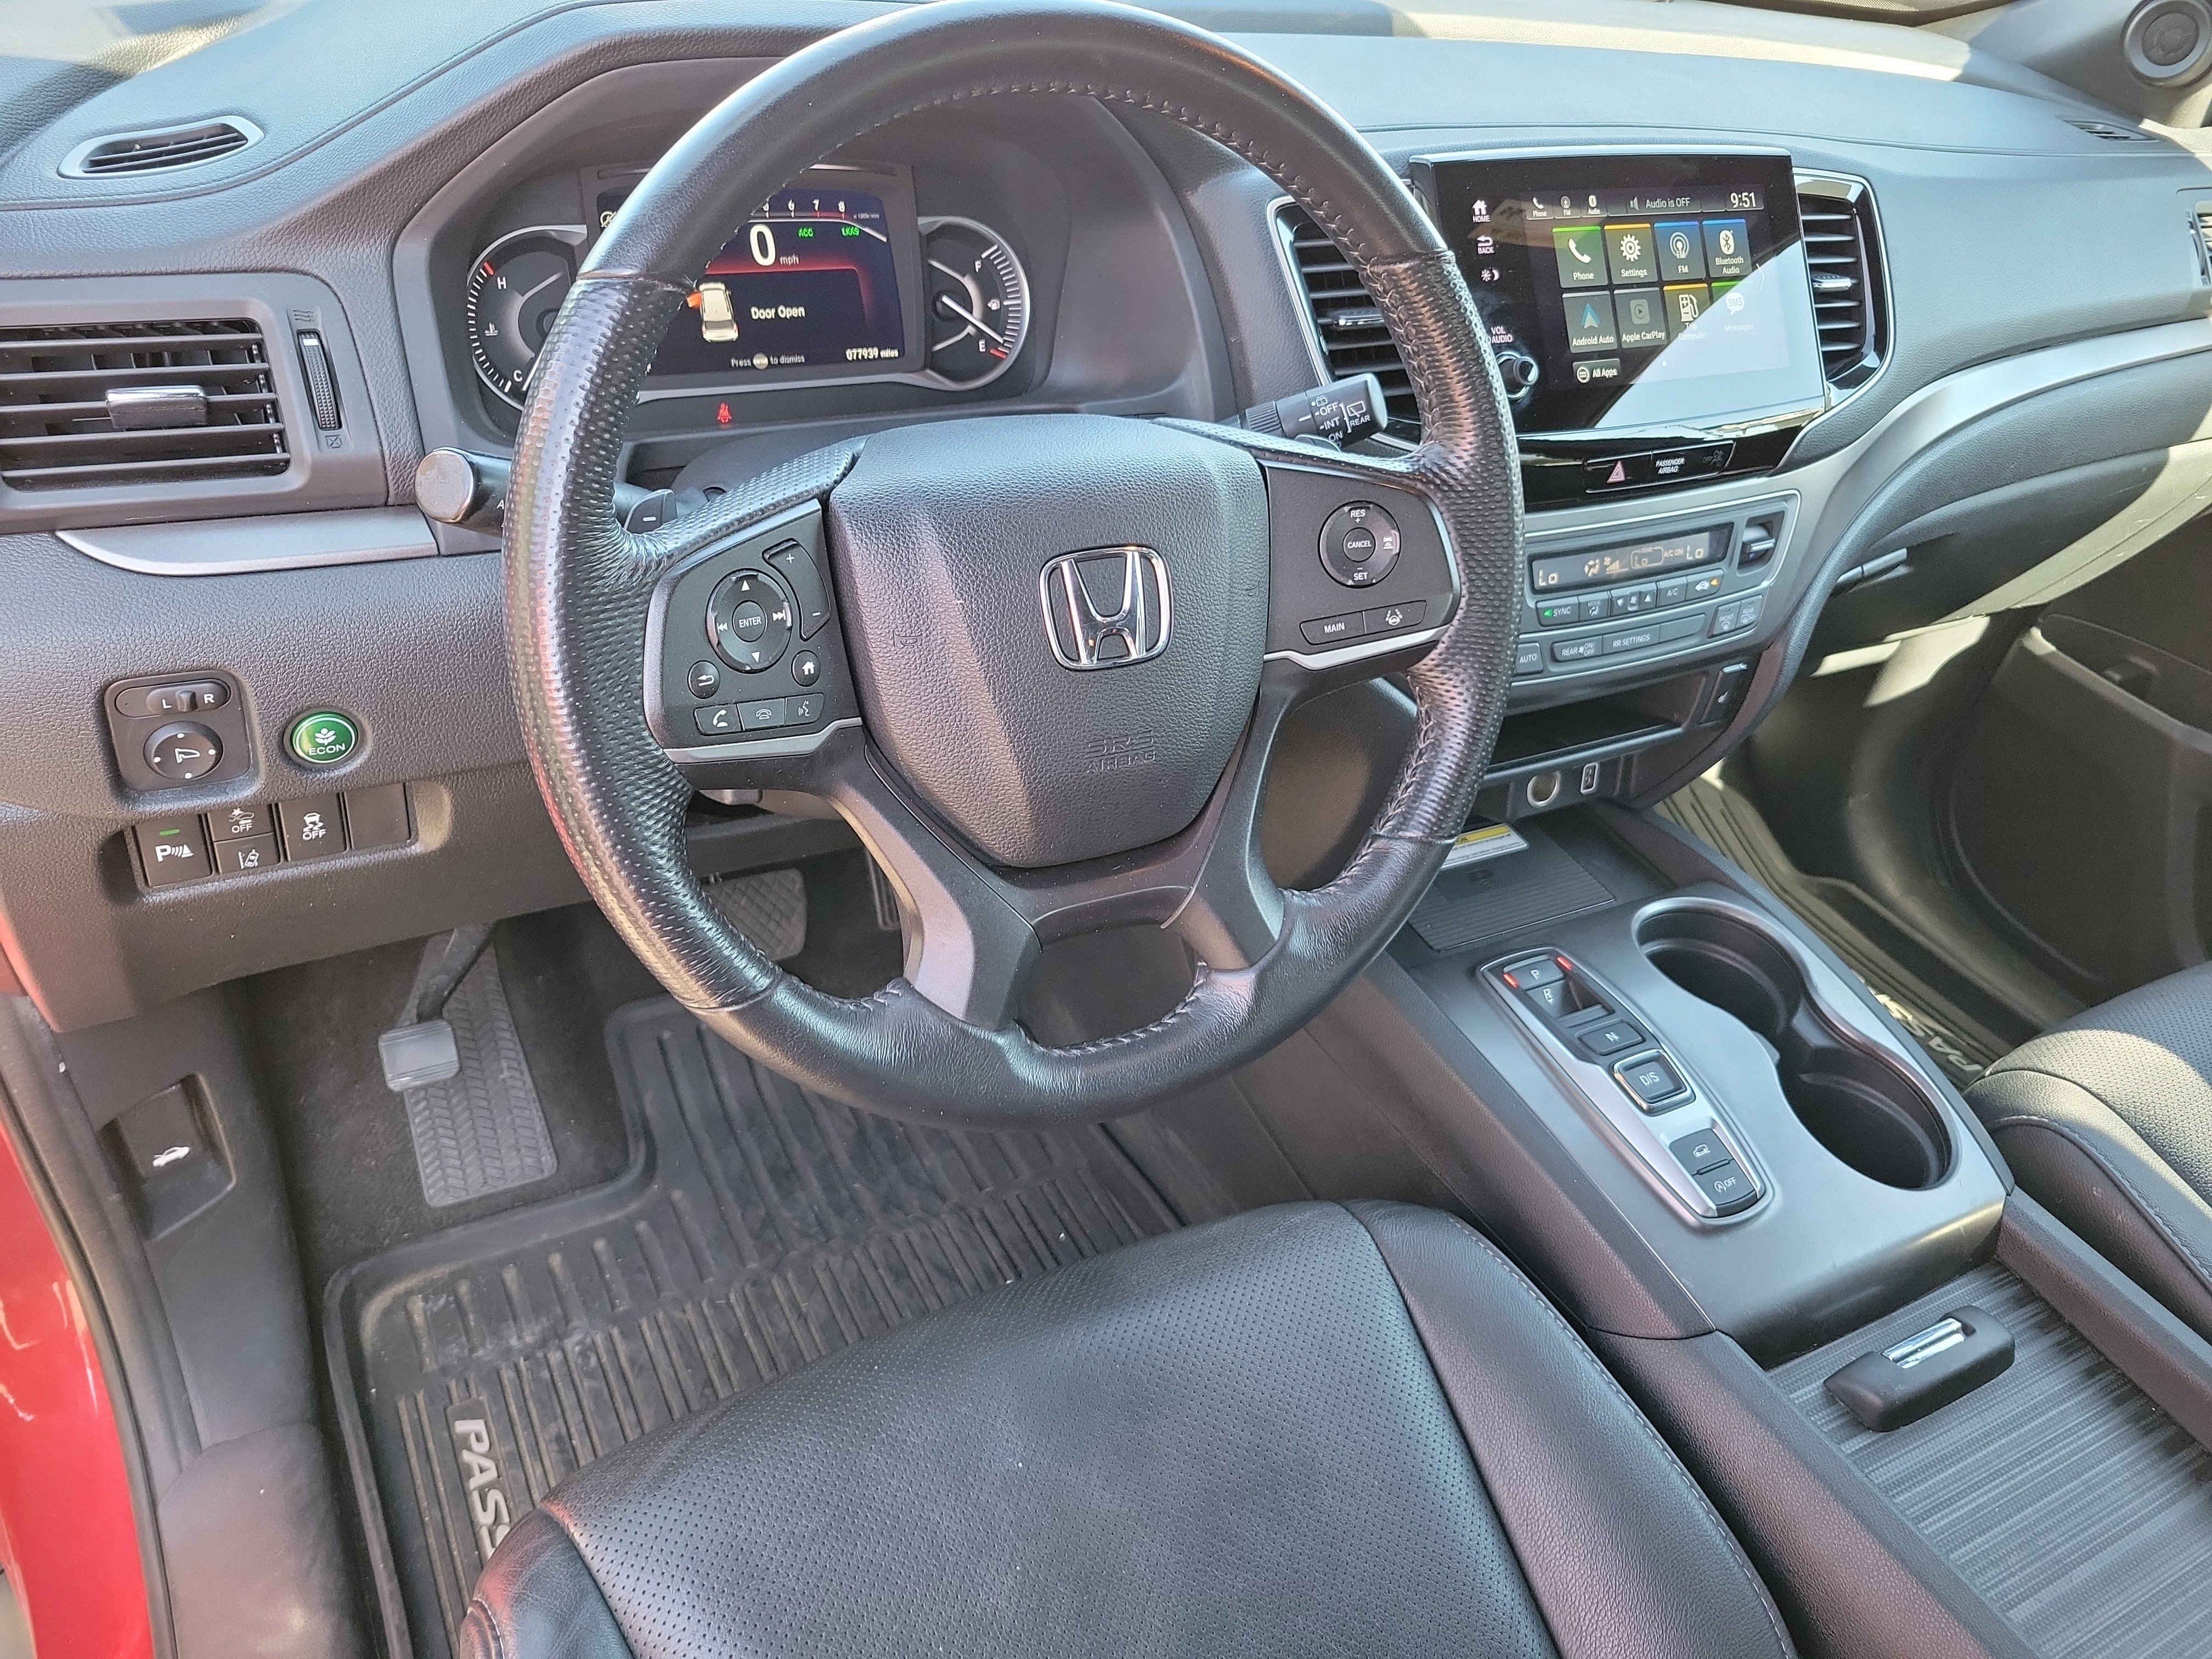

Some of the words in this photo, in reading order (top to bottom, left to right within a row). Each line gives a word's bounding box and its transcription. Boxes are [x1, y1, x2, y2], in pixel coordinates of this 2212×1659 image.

[788, 199, 795, 211] 6
[813, 199, 820, 211] 7
[1646, 199, 1666, 209] Audio
[1668, 198, 1674, 207] is
[1676, 198, 1690, 207] OFF
[1730, 193, 1756, 208] 9:51
[798, 228, 814, 238] ACC
[842, 227, 860, 236] LKAS
[750, 224, 776, 266] 0
[780, 253, 799, 266] mph
[1676, 251, 1685, 259] FM
[975, 260, 981, 272] F
[1716, 257, 1744, 265] Bluetooth
[1621, 268, 1647, 278] Settings
[1723, 266, 1740, 274] Audio
[1573, 272, 1594, 280] Phone
[497, 276, 507, 289] H
[1728, 297, 1743, 307] SMS
[751, 306, 776, 319] Door
[777, 305, 805, 319] Open
[1491, 326, 1506, 334] VOL
[1724, 323, 1754, 332] Messages
[1492, 334, 1513, 343] AUDIO
[1572, 336, 1598, 346] Android
[1599, 335, 1614, 344] Auto
[1622, 332, 1640, 342] Apple
[1641, 331, 1665, 342] CarPlay
[1678, 331, 1707, 341] Computer
[979, 339, 986, 352] E
[846, 347, 878, 360] 077939
[880, 348, 899, 358] miles
[731, 358, 751, 367] Press
[770, 356, 778, 364] to
[779, 353, 805, 363] dismiss
[514, 370, 523, 381] C
[1593, 368, 1601, 377] All
[1602, 368, 1618, 379] Apps
[1320, 403, 1338, 416] OFF
[1324, 416, 1340, 430] INT
[1350, 415, 1370, 427] REAR
[1328, 431, 1343, 441] ON
[1656, 458, 1685, 467] PASSENGER
[1658, 465, 1679, 475] AIRBAG
[1350, 509, 1366, 518] RES
[1353, 572, 1368, 580] SET
[1667, 588, 1679, 597] A/C
[1553, 607, 1571, 617] SYNC
[738, 616, 761, 627] ENTER
[1719, 614, 1734, 622] FRONT
[1324, 622, 1345, 634] MAIN
[1613, 640, 1622, 648] RR
[1622, 634, 1650, 646] SETTINGS
[1562, 648, 1578, 656] REAR
[1519, 653, 1536, 664] AUTO
[162, 699, 172, 709] L
[204, 693, 215, 704] R
[308, 743, 346, 756] ECON
[231, 823, 253, 833] OFF
[302, 828, 327, 841] OFF
[1531, 969, 1540, 980] P
[1543, 988, 1552, 999] R
[1605, 1031, 1620, 1042] N
[1638, 1072, 1660, 1086] D/S
[1724, 1177, 1737, 1187] OFF
